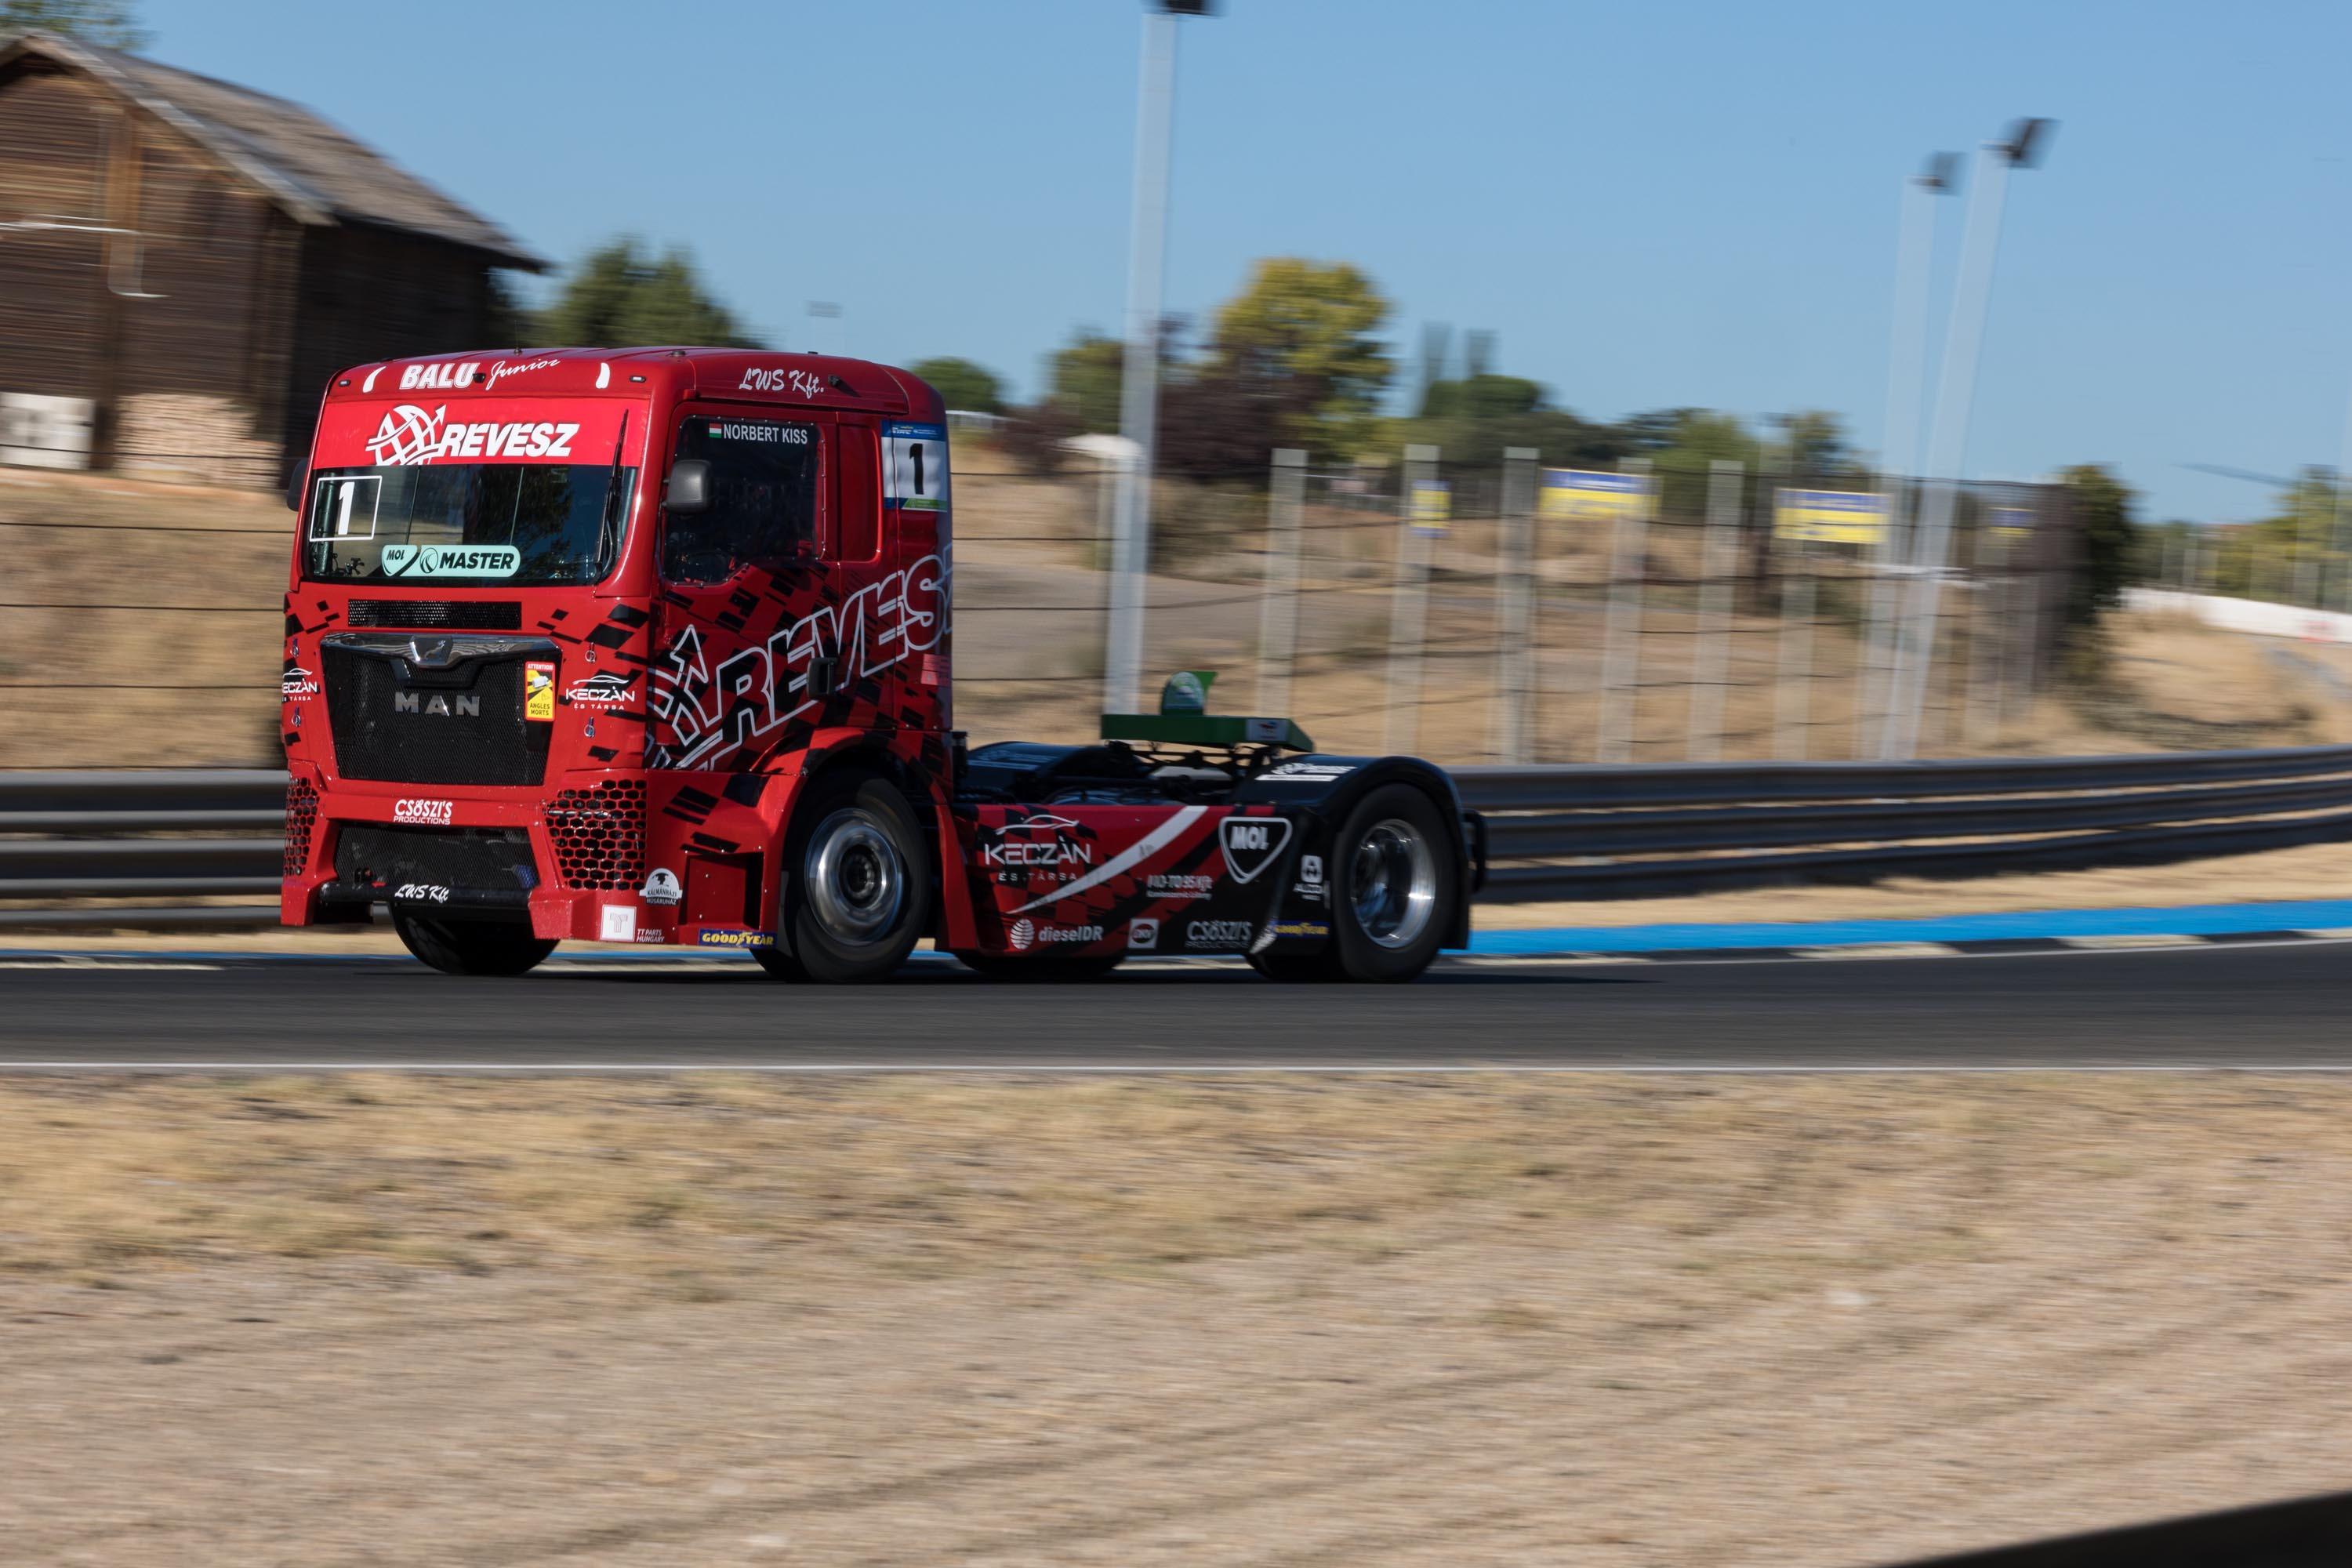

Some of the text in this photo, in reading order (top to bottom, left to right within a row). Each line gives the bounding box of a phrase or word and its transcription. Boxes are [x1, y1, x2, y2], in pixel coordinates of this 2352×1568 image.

[399, 362, 481, 390] BALU
[739, 368, 825, 399] LWS Kft.
[440, 423, 581, 458] REVESZ
[724, 423, 808, 445] NORBERT KISS
[909, 443, 924, 495] 1
[338, 481, 355, 535] 1
[439, 551, 514, 570] MASTER
[394, 691, 481, 717] MAN
[394, 815, 452, 826] PRODUCTIONS
[1230, 826, 1270, 851] MOL
[702, 932, 774, 946] GOODYEAR
